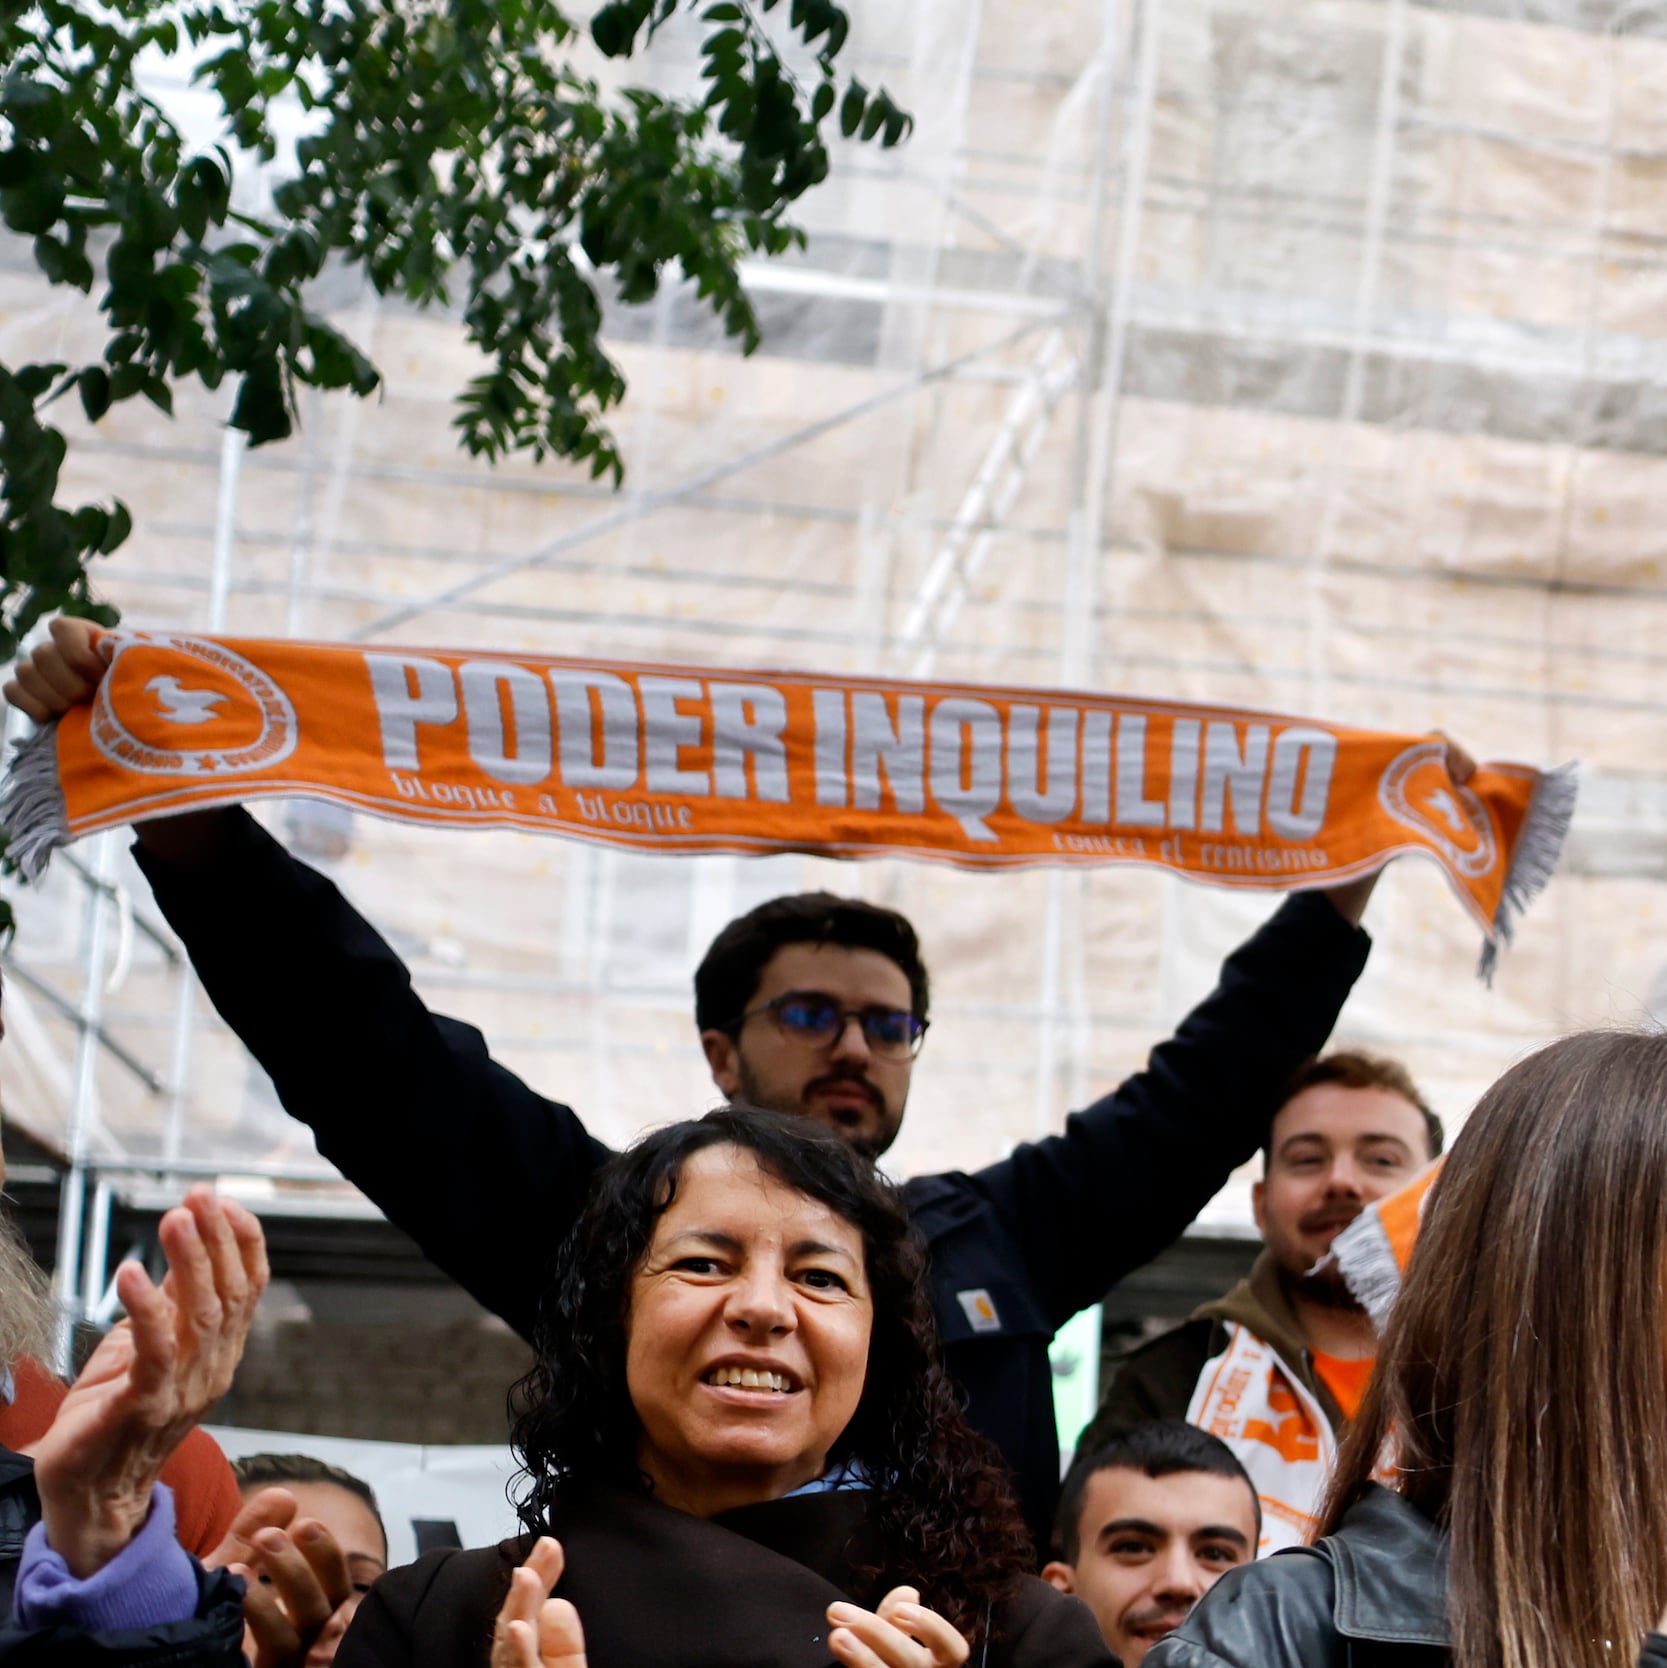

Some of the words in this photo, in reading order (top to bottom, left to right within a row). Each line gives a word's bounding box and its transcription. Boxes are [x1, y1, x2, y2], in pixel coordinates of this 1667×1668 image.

[362, 652, 790, 804] PODER
[811, 687, 1337, 842] INQUILINO
[390, 772, 515, 810] bloque
[538, 793, 558, 815] a
[575, 790, 693, 832] bloque
[1160, 833, 1184, 864] el
